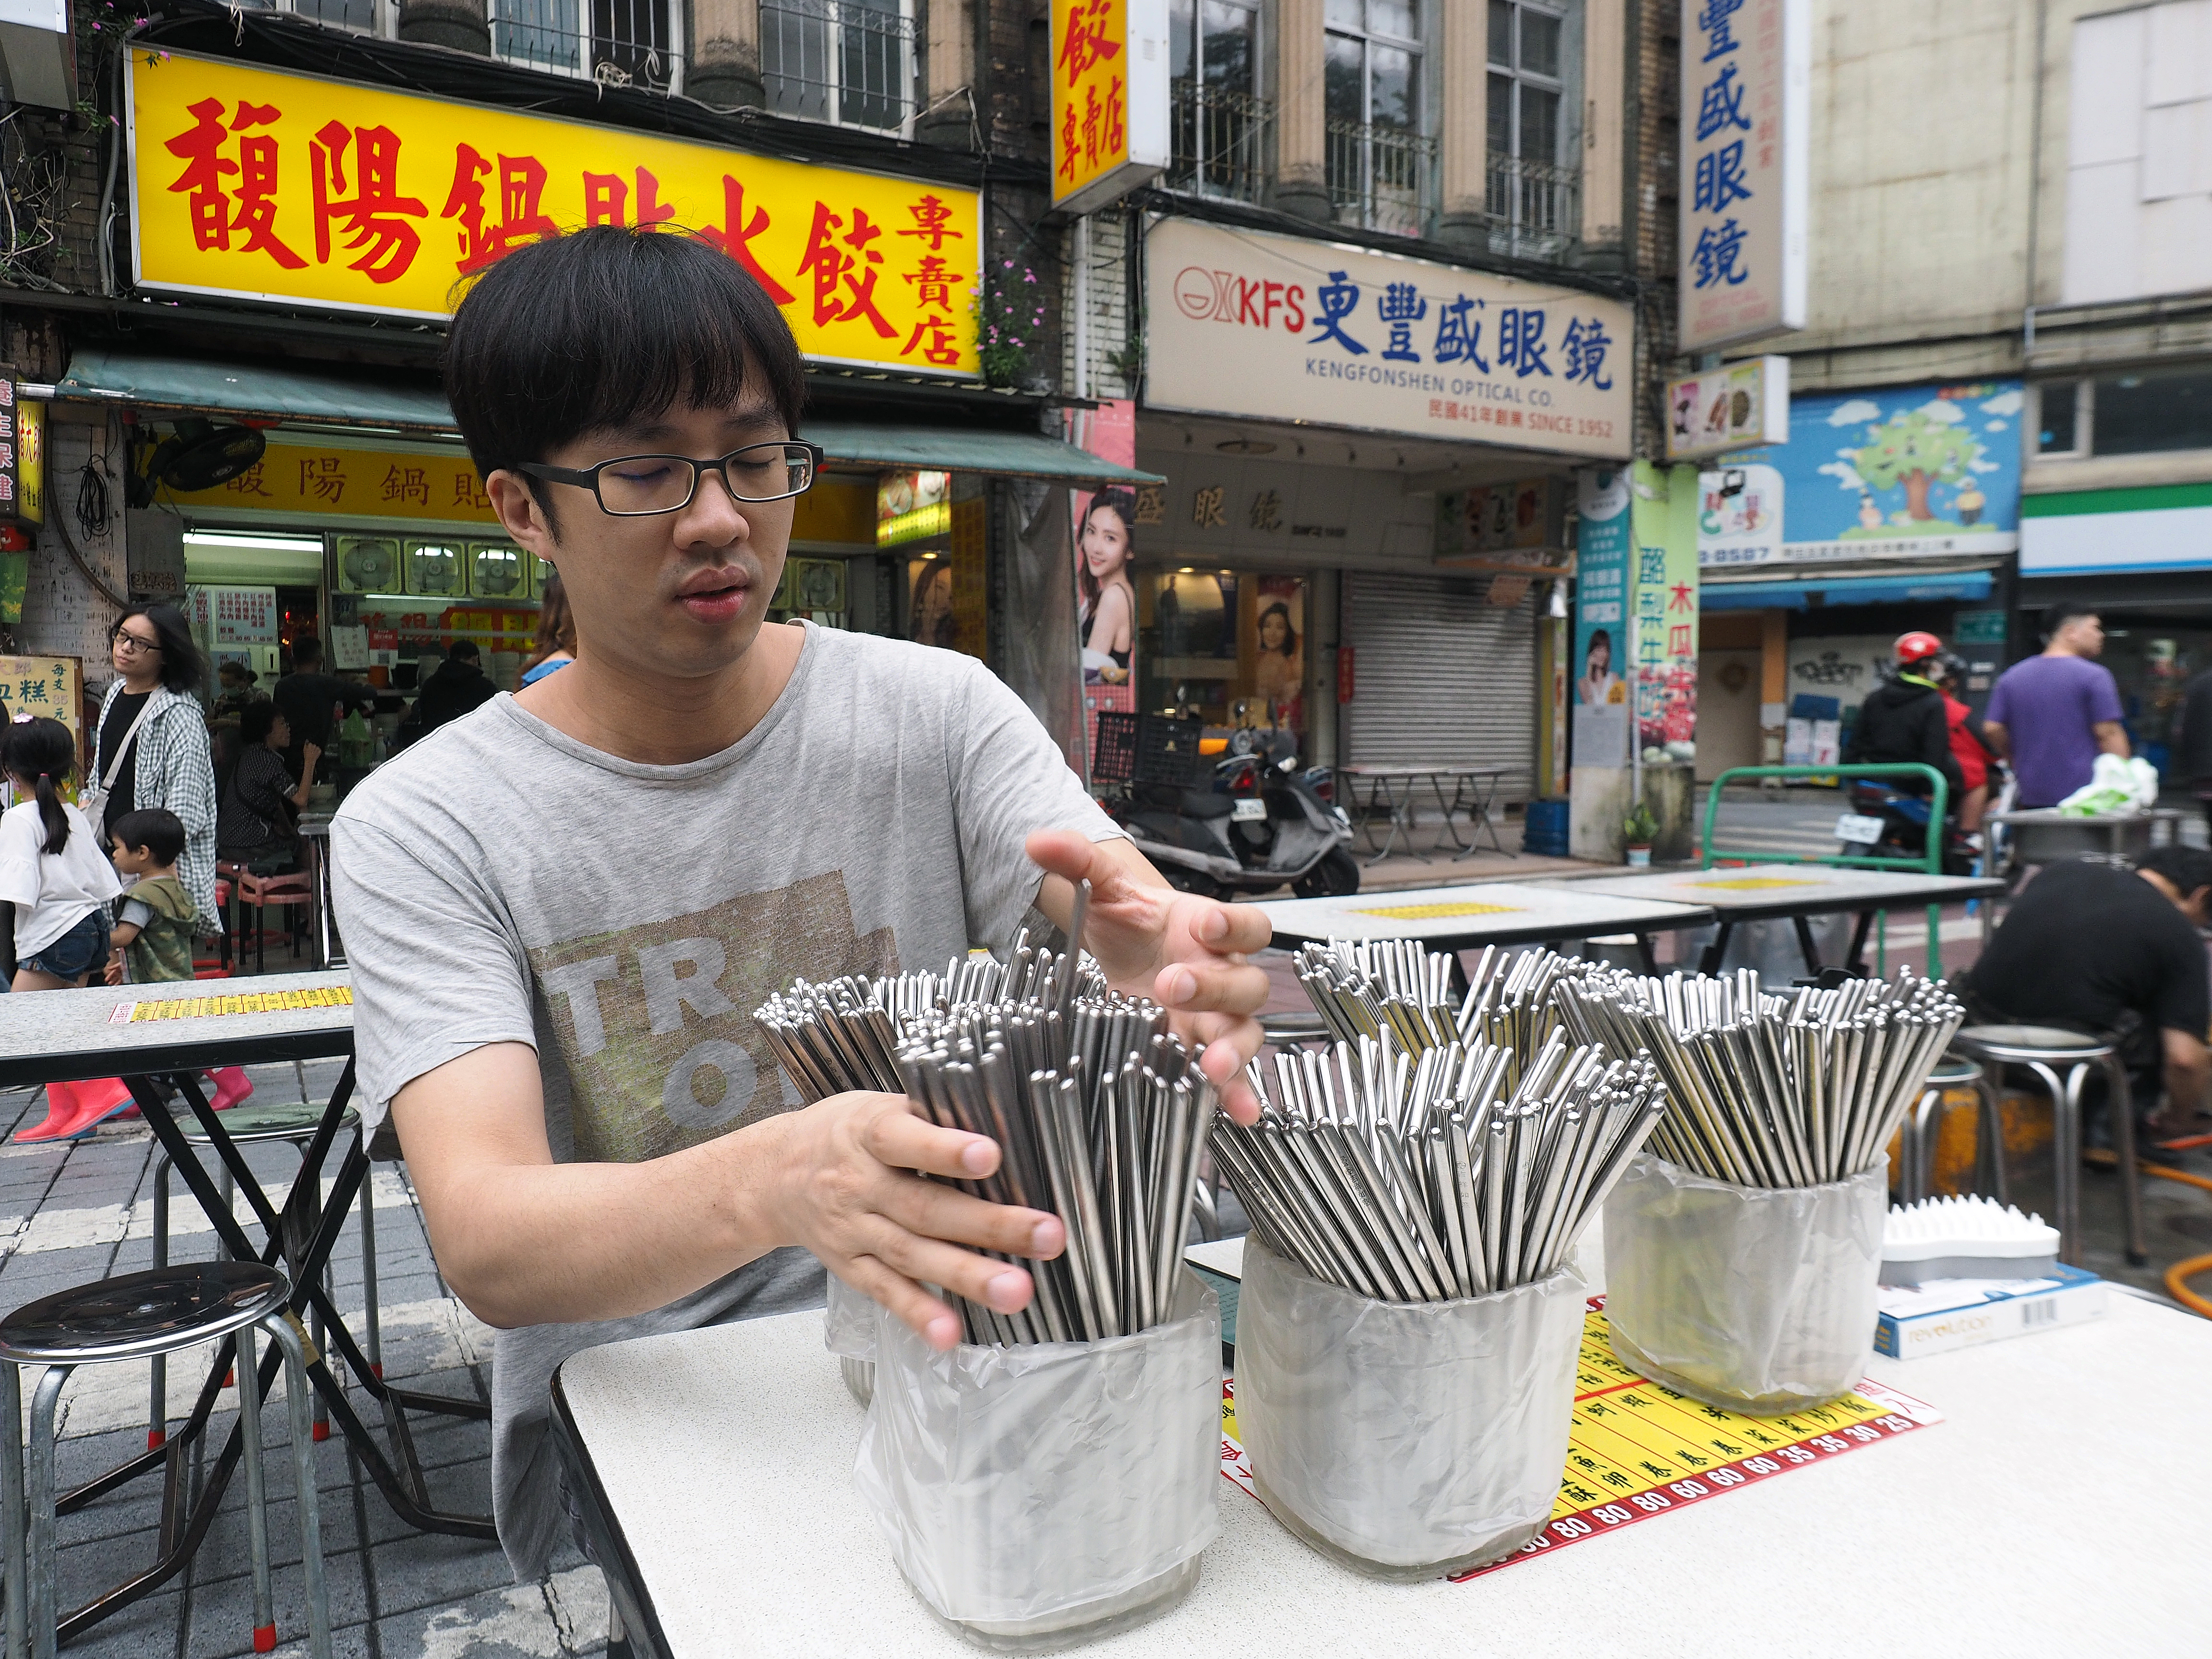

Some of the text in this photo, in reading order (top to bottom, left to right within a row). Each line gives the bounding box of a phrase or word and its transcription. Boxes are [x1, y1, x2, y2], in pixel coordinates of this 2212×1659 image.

[1059, 76, 1123, 182] 專賣店
[1690, 0, 1752, 289] 豐盛眼鏡
[897, 194, 963, 366] 專賣店
[1238, 276, 1305, 333] KFS
[1308, 271, 1612, 390] 更豐盛眼鏡
[1305, 358, 1444, 394] KENGFONSHEN
[1451, 378, 1522, 403] OPTICAL
[1528, 412, 1573, 434] SINCE
[1578, 416, 1614, 439] 1952
[541, 936, 737, 1057] TR
[1843, 1425, 1882, 1442] 30
[1874, 1415, 1914, 1432] 25
[1810, 1434, 1849, 1453] 35
[1777, 1445, 1816, 1464] 35
[1741, 1456, 1781, 1475] 60
[1707, 1467, 1746, 1487] 60
[1670, 1479, 1709, 1499] 60
[1631, 1491, 1672, 1512] 80
[1591, 1504, 1633, 1525] 80
[1551, 1517, 1592, 1538] 80
